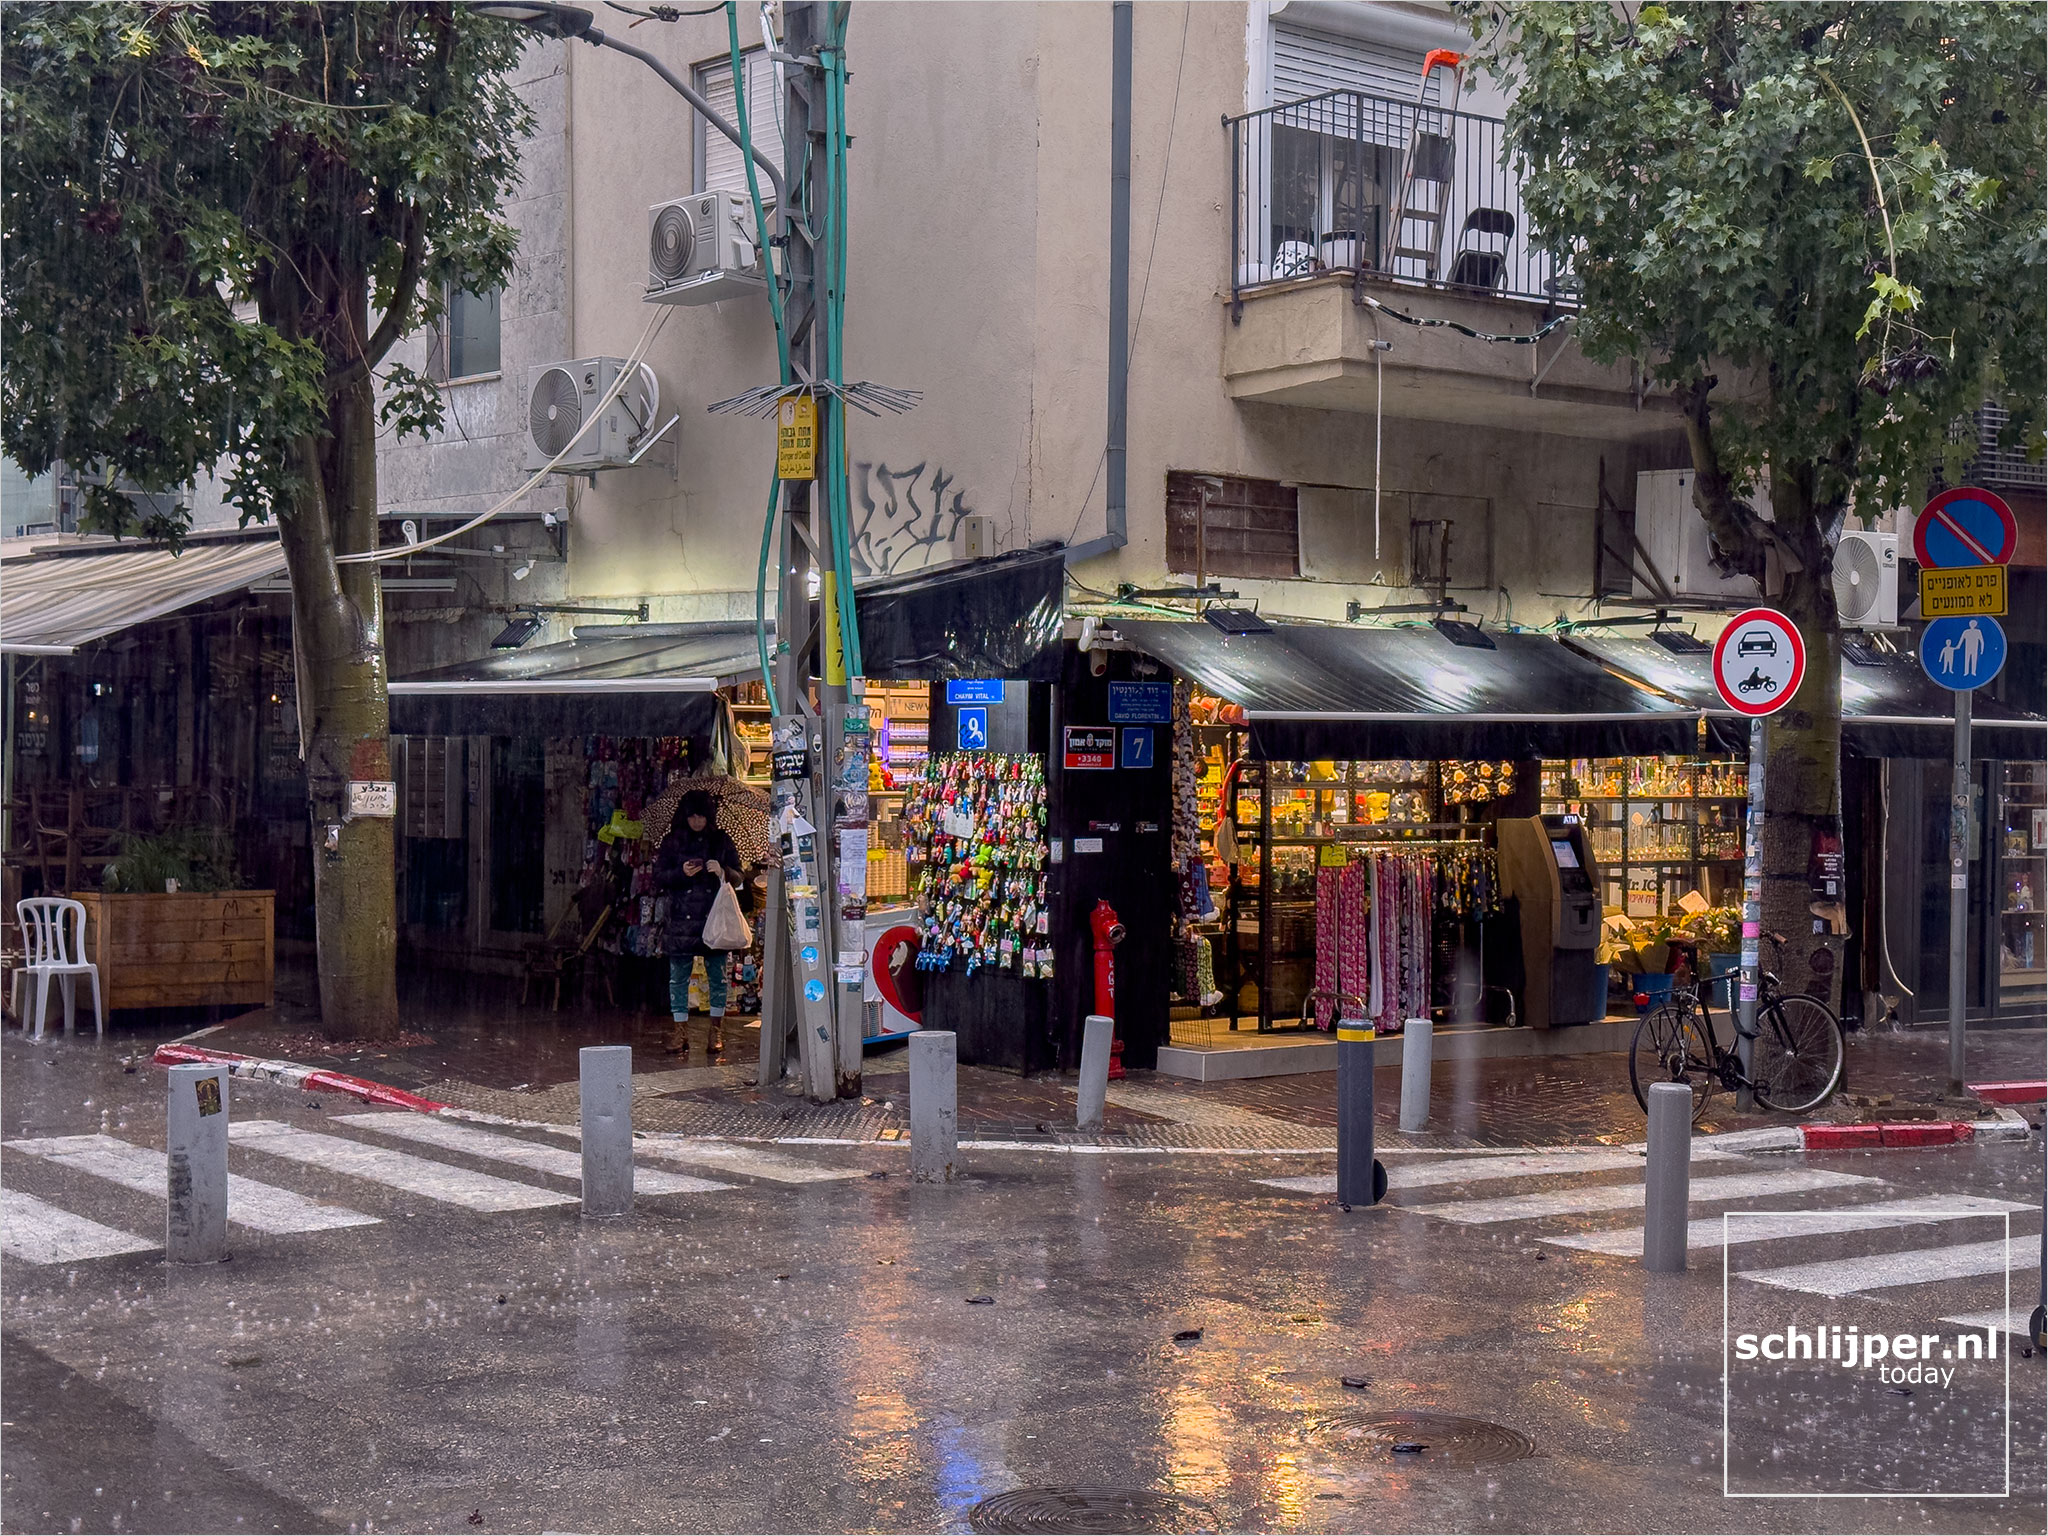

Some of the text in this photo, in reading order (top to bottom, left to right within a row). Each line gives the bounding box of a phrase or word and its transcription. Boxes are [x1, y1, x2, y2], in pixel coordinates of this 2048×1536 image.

[1927, 574, 1997, 590] פרט לאופניים
[1932, 592, 1993, 609] לא ממונעים
[18, 733, 46, 748] כניסה
[1069, 738, 1112, 748] מוקד אמון
[1133, 737, 1145, 759] 7
[1563, 815, 1578, 824] ATM
